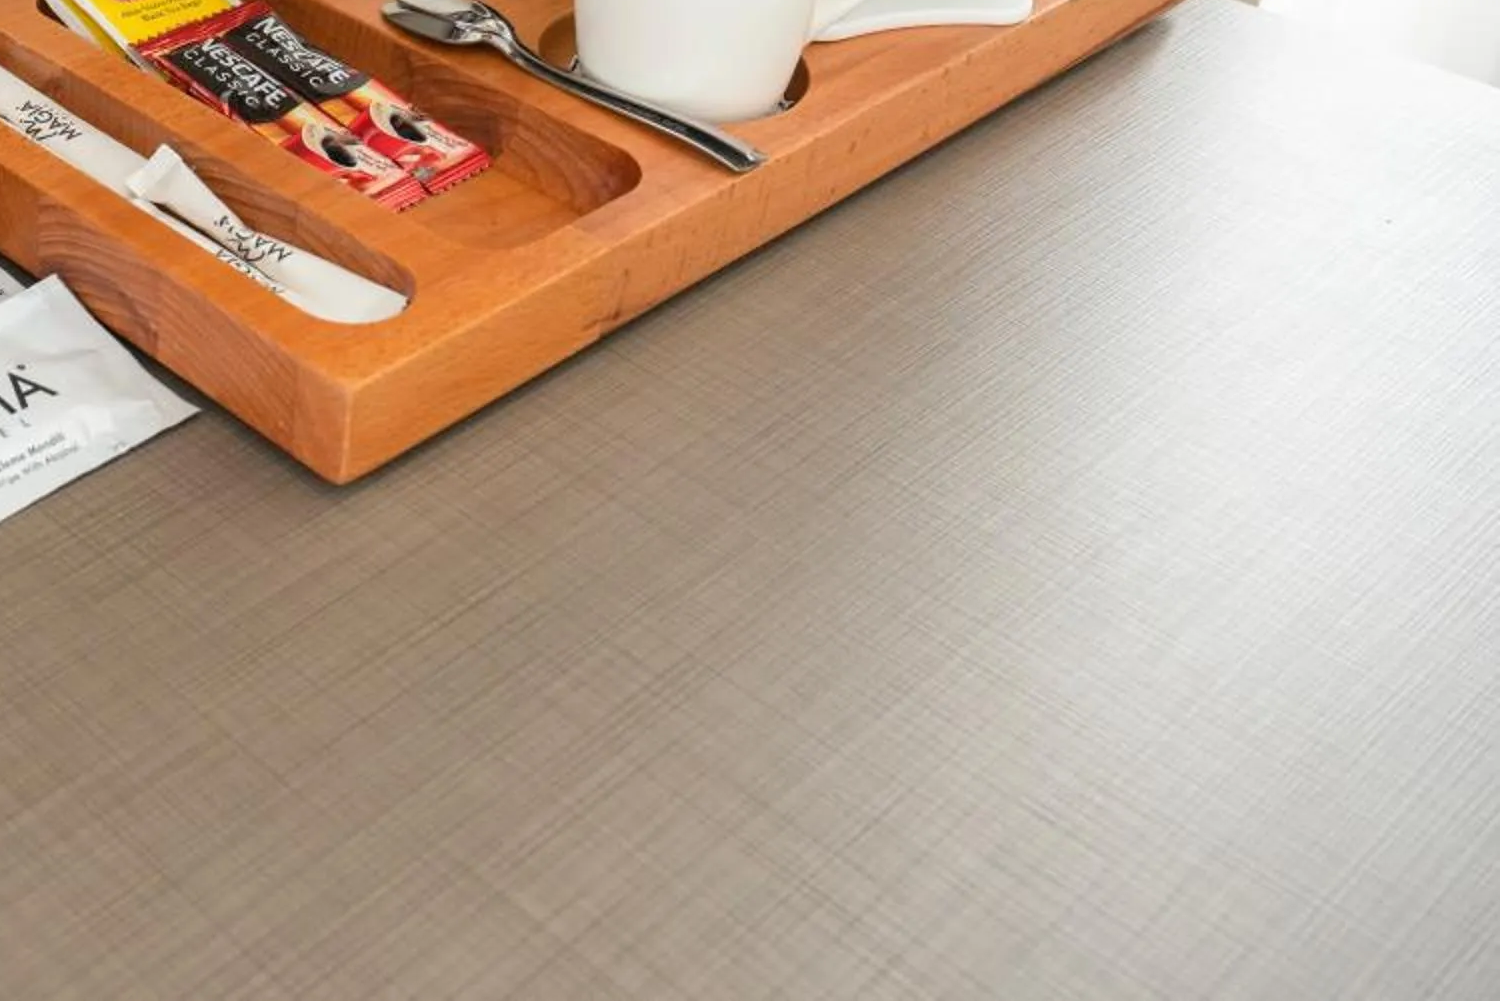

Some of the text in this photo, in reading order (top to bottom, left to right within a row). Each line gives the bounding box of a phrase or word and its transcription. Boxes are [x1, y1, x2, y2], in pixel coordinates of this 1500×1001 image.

[184, 50, 260, 108] CLASSIC
[245, 32, 324, 88] CLASSIC
[20, 100, 83, 141] MAGIA
